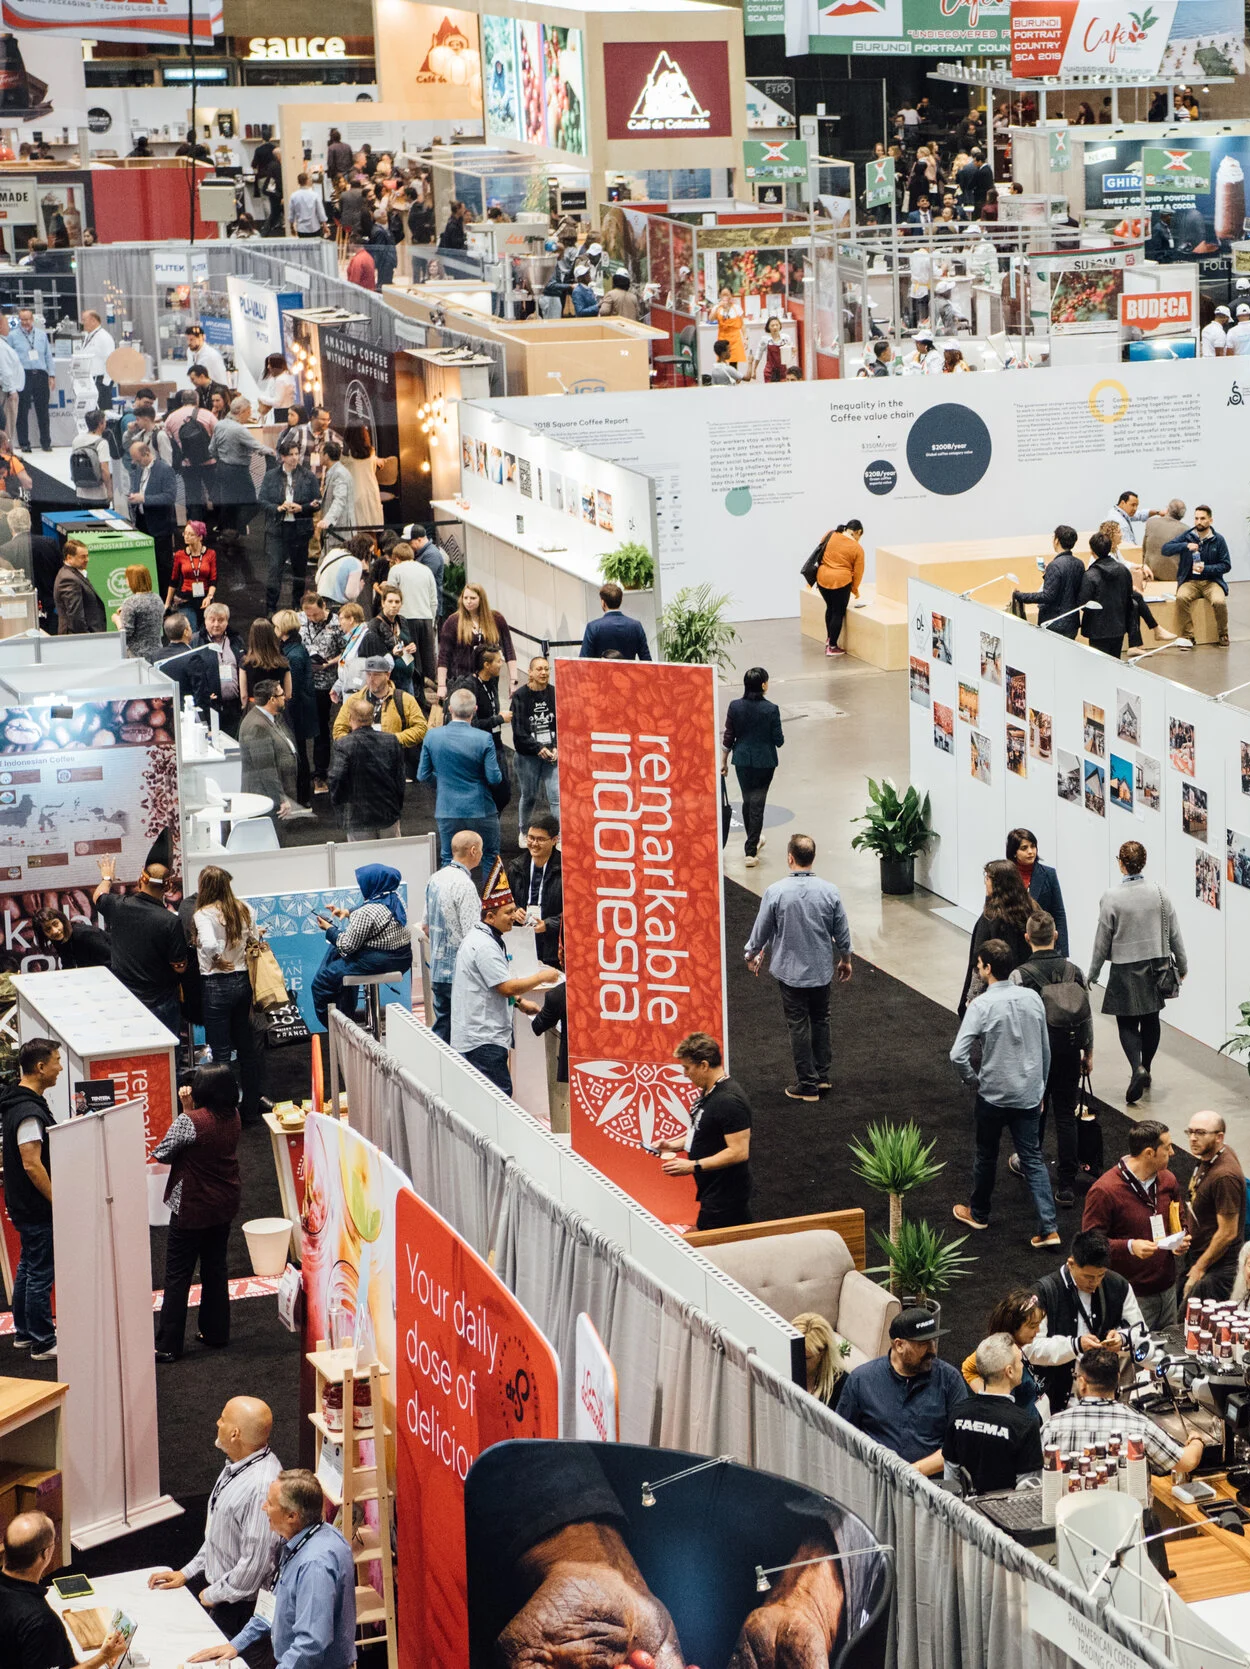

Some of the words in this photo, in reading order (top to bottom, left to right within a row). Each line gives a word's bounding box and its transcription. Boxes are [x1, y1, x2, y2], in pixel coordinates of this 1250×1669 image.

[1014, 19, 1060, 28] BURUNDI
[1014, 30, 1062, 39] PORTRAIT
[249, 36, 346, 58] sauce
[855, 42, 911, 52] BURUNDI
[914, 43, 973, 53] PORTRAIT
[978, 43, 1011, 53] COUN
[1014, 41, 1061, 50] COUNTRY
[1014, 53, 1035, 61] SCA
[1164, 194, 1197, 202] POWDER
[155, 263, 186, 273] PLITEK
[1126, 296, 1189, 320] BUDECA
[325, 334, 357, 357] AMAZING
[359, 347, 388, 369] COFFEE
[326, 350, 354, 370] WITHOUT
[357, 362, 389, 384] CAFFEINE
[830, 400, 876, 411] Inequality
[878, 400, 886, 408] in
[888, 399, 903, 407] the
[552, 420, 578, 429] Square
[579, 417, 603, 426] Coffee
[605, 417, 629, 427] Report
[830, 413, 862, 423] Coffee
[864, 412, 888, 421] value
[890, 411, 915, 419] chain
[931, 443, 967, 451] $200B/year
[864, 470, 897, 478] $20B/year
[87, 542, 134, 551] OMPOSTABLES
[4, 756, 48, 767] Indonesian
[50, 755, 75, 764] Coffee
[638, 734, 690, 1025] remarkable
[276, 1029, 308, 1039] FRANCE
[406, 1243, 449, 1322] Your
[453, 1290, 498, 1375] daily
[915, 1318, 936, 1330] FAEMA
[406, 1320, 452, 1395] dose
[456, 1370, 476, 1416] of
[406, 1390, 473, 1481] delicio
[954, 1419, 1009, 1440] FAEMA
[1068, 1611, 1112, 1660] PANAMERICAN
